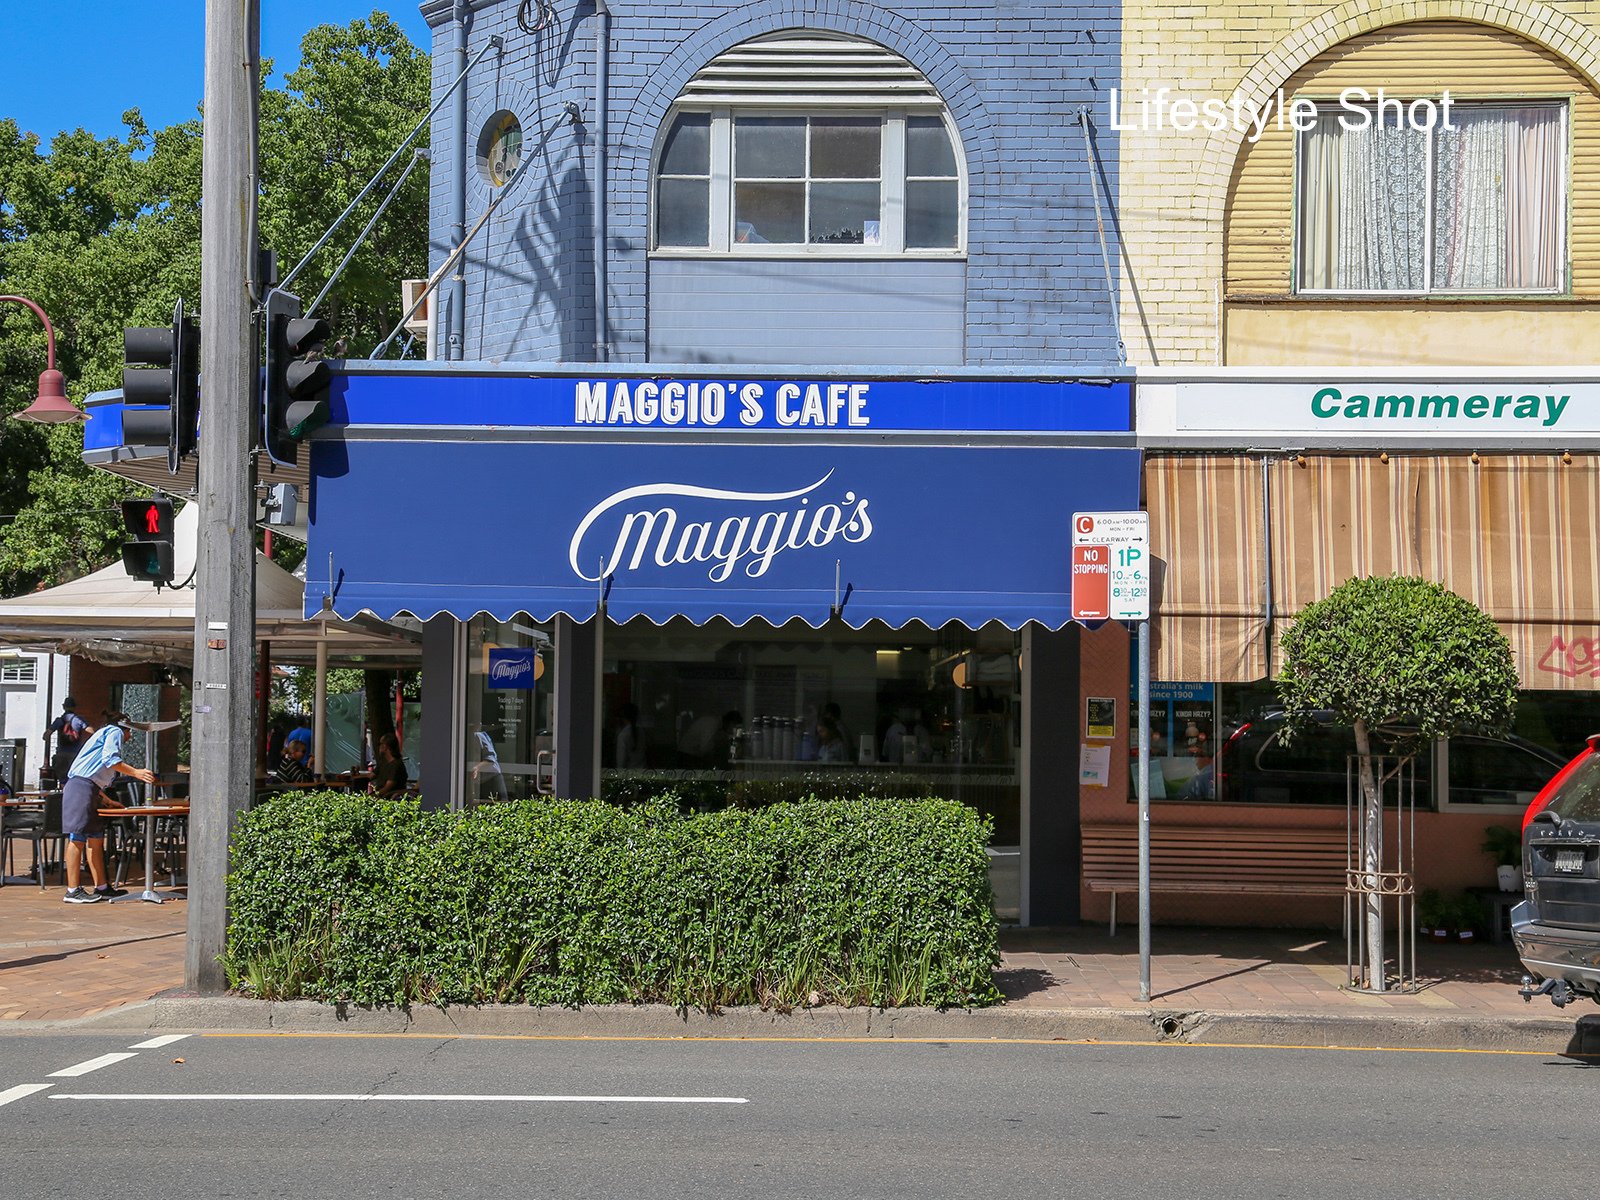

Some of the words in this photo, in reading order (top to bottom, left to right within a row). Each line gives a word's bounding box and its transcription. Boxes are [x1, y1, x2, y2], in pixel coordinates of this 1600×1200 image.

[575, 382, 764, 426] MAGGIO'S
[776, 383, 870, 427] CAFE
[1311, 388, 1571, 427] Cammeray
[569, 467, 873, 583] Maggio's
[1080, 517, 1090, 532] C
[1083, 550, 1098, 561] NO
[1119, 548, 1141, 567] 1P
[1074, 564, 1108, 574] STOPPING
[492, 656, 531, 680] Maggio's
